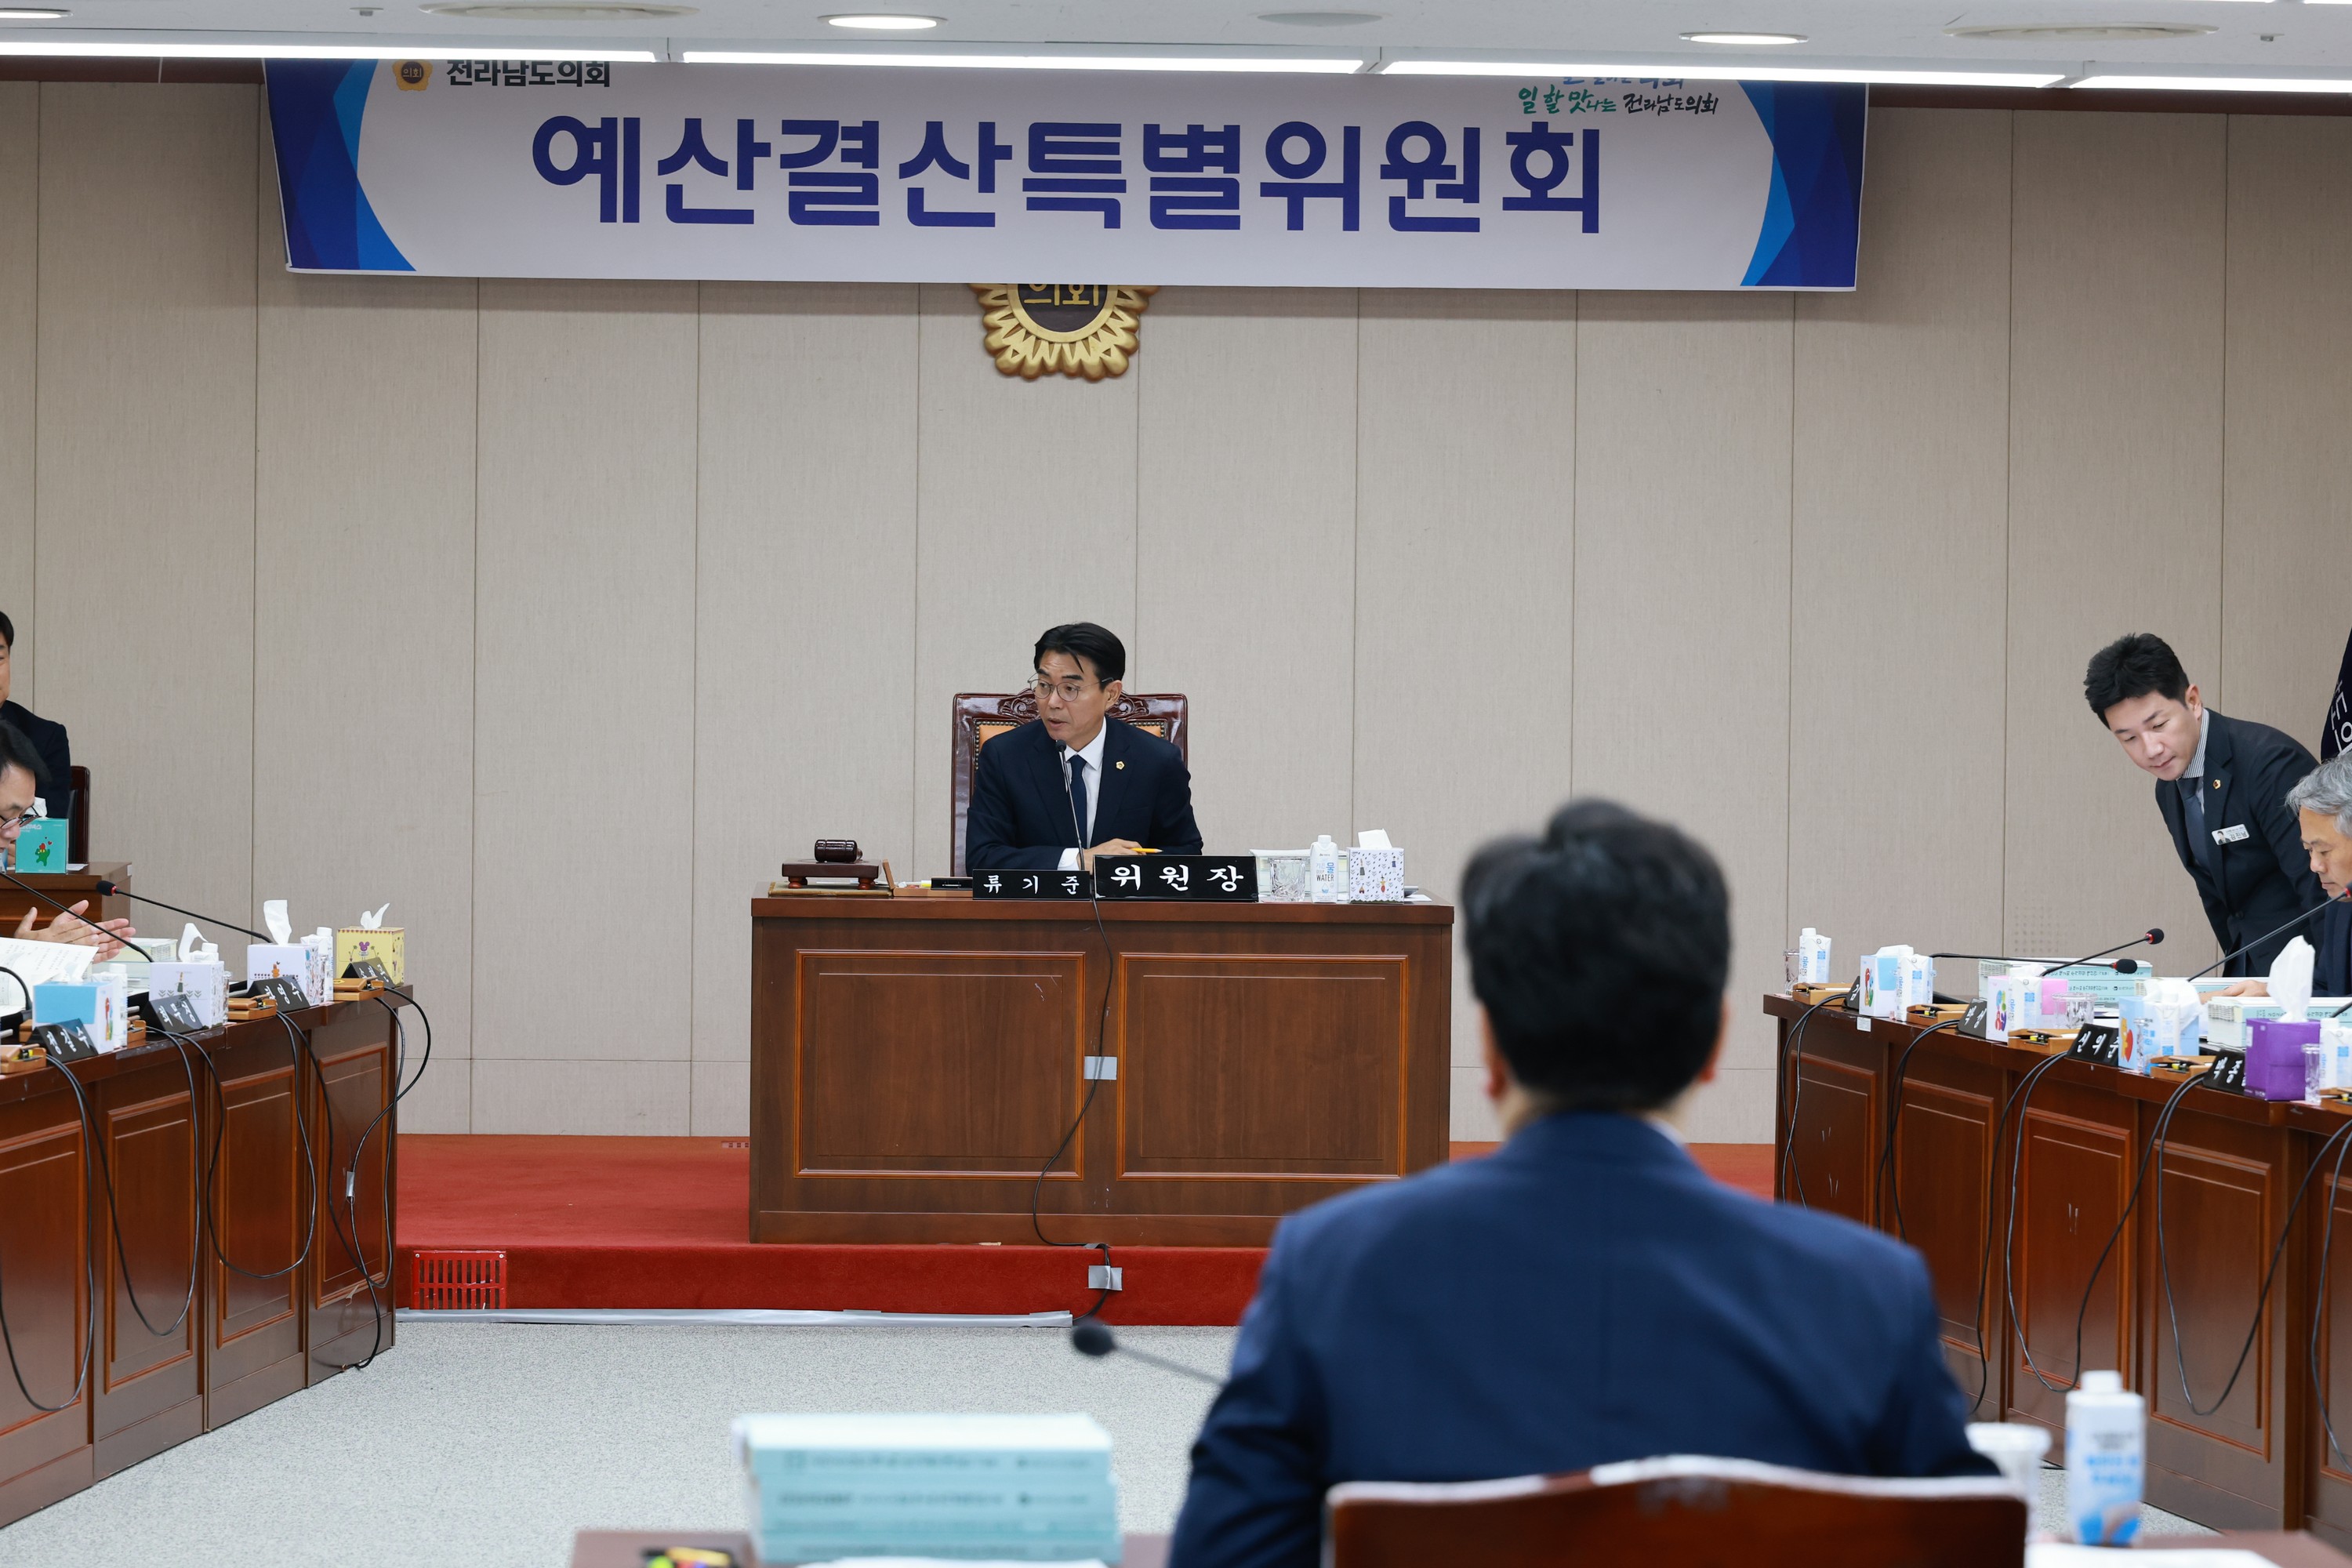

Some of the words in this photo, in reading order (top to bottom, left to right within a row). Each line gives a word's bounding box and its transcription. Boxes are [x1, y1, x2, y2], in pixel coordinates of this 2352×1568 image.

[403, 67, 422, 78] 의회
[446, 60, 610, 88] 전라남도의회
[1622, 93, 1719, 116] 전라남도의회
[532, 115, 1599, 234] 예산결산특별위원회
[983, 874, 1080, 895] 류기준
[1110, 864, 1244, 893] 위원장
[2212, 1057, 2246, 1087] 박종
